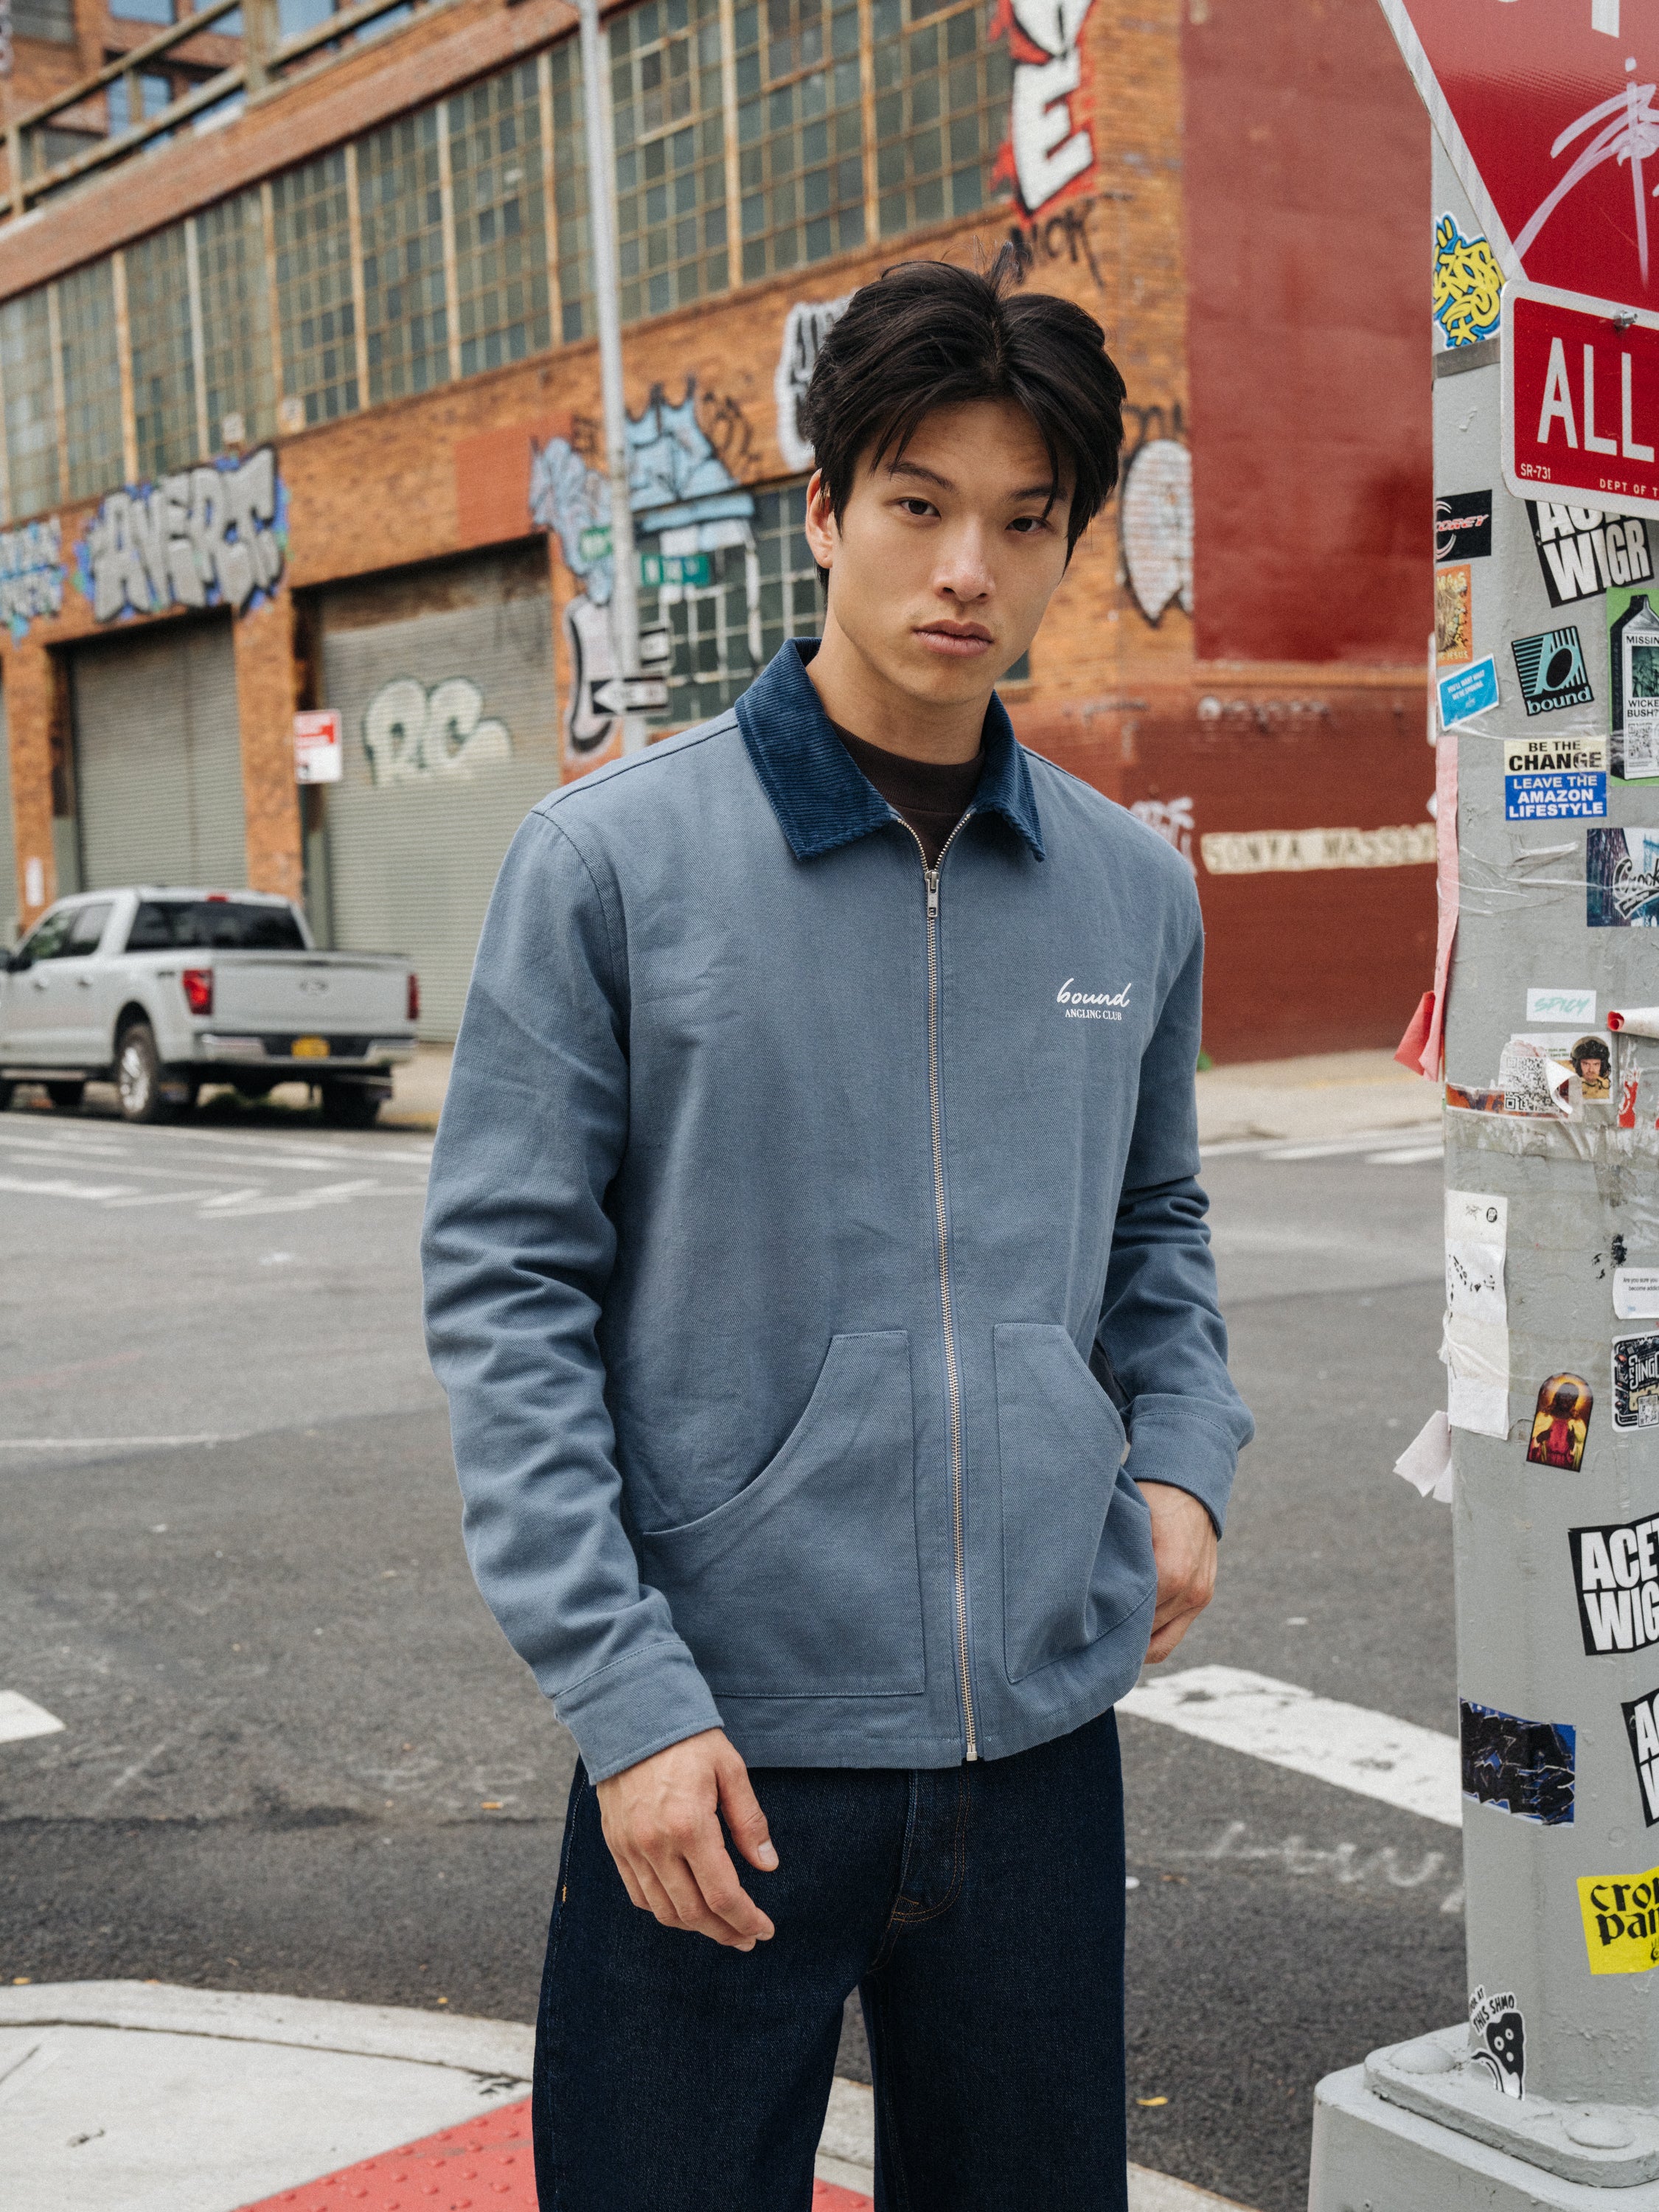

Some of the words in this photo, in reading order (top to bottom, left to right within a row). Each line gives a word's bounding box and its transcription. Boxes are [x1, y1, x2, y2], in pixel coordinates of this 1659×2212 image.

[1537, 336, 1655, 463] ALL
[1520, 463, 1551, 480] SR-731
[1599, 479, 1627, 493] DEPT
[1633, 485, 1646, 495] OF
[1543, 519, 1651, 602] WIGR
[1526, 686, 1592, 714] bound
[1528, 742, 1548, 752] BE
[1552, 740, 1581, 751] THE
[1509, 751, 1601, 771] CHANGE
[1513, 776, 1562, 790] LEAVE
[1567, 775, 1598, 787] THE
[1517, 788, 1593, 804] AMAZON
[1509, 801, 1604, 818] LIFESTYLE
[1057, 978, 1132, 1007] bound
[1065, 1009, 1102, 1019] ANGLING
[1102, 1010, 1122, 1020] CLUB
[1473, 2006, 1489, 2033] THIS
[1489, 1994, 1514, 2014] SHMO
